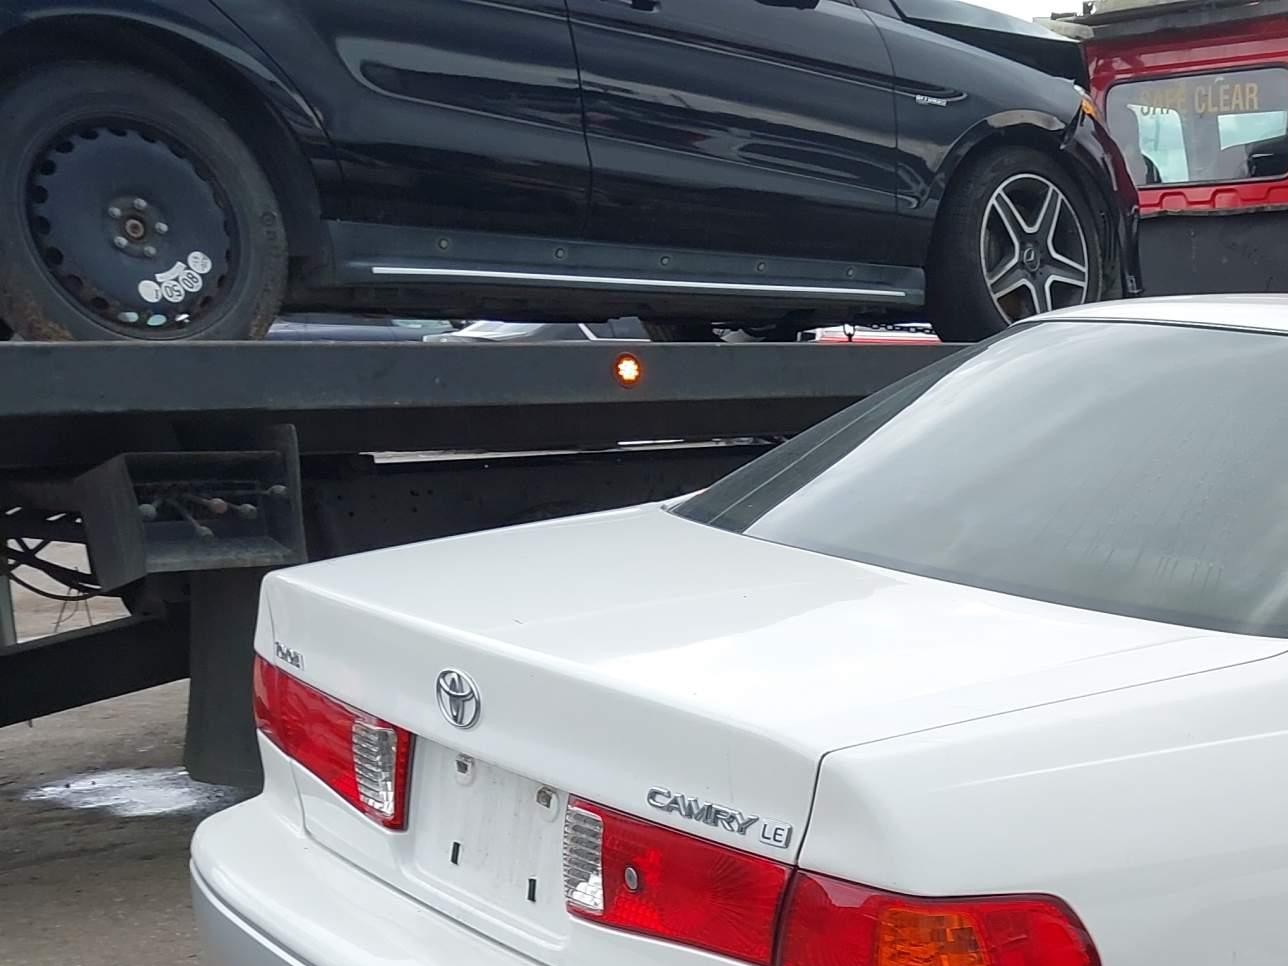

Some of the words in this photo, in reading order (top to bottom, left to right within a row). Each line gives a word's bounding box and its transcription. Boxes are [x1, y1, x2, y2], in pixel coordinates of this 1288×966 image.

[1138, 87, 1186, 115] SAFE
[1194, 83, 1259, 113] CLEAR
[647, 785, 759, 836] CAMRY
[761, 823, 785, 843] LE
